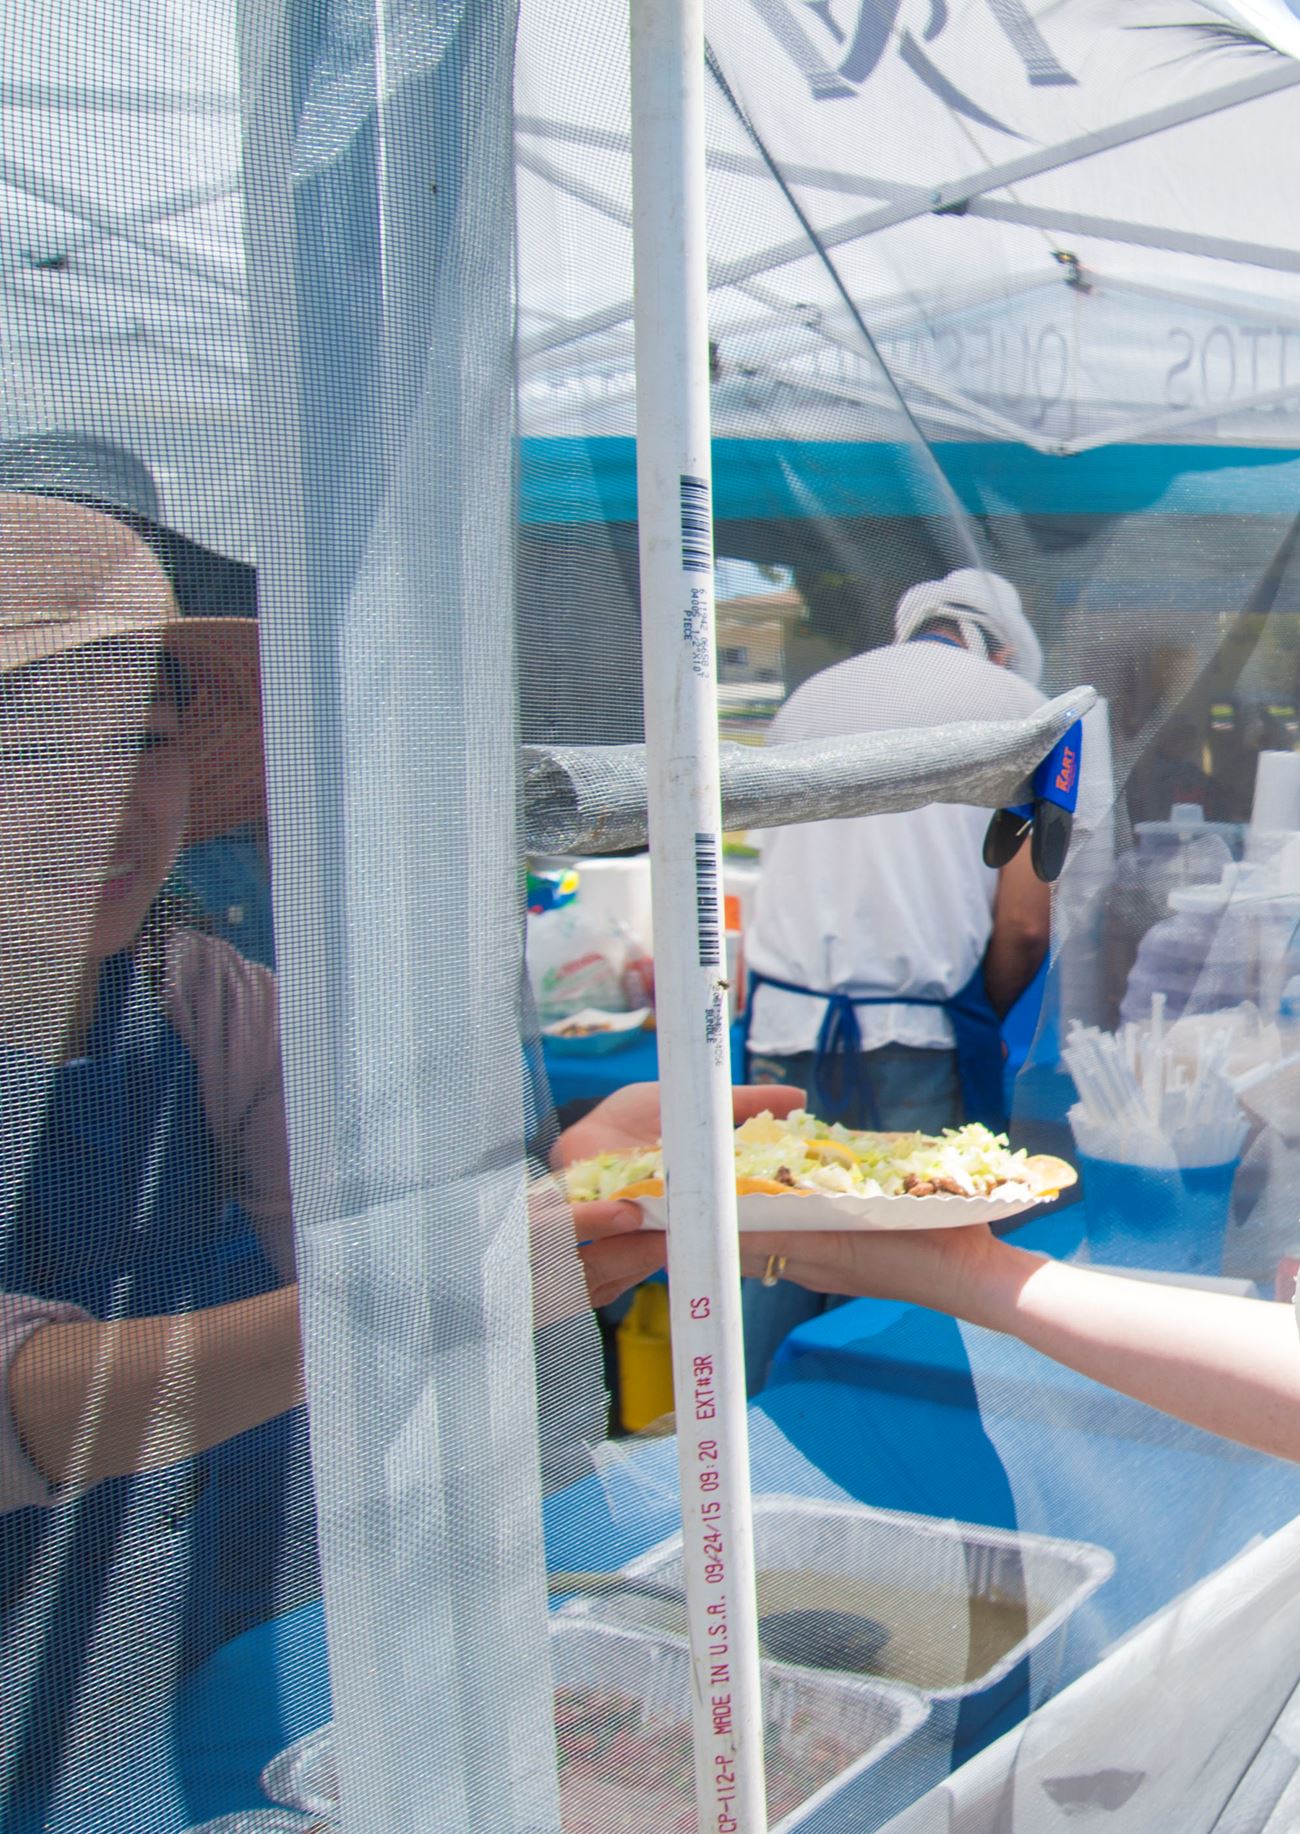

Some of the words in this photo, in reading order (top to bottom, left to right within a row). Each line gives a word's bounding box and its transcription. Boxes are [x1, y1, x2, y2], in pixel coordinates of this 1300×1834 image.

[683, 609, 693, 640] PIECE
[705, 1008, 716, 1044] BUNDLE
[690, 1296, 711, 1320] CS
[693, 1354, 716, 1421] EXT#3R
[697, 1439, 719, 1492] 09:20
[701, 1502, 723, 1584] 09/24/15
[706, 1595, 728, 1656] U.S.A.
[709, 1663, 730, 1684] IN
[711, 1695, 733, 1735] MADE
